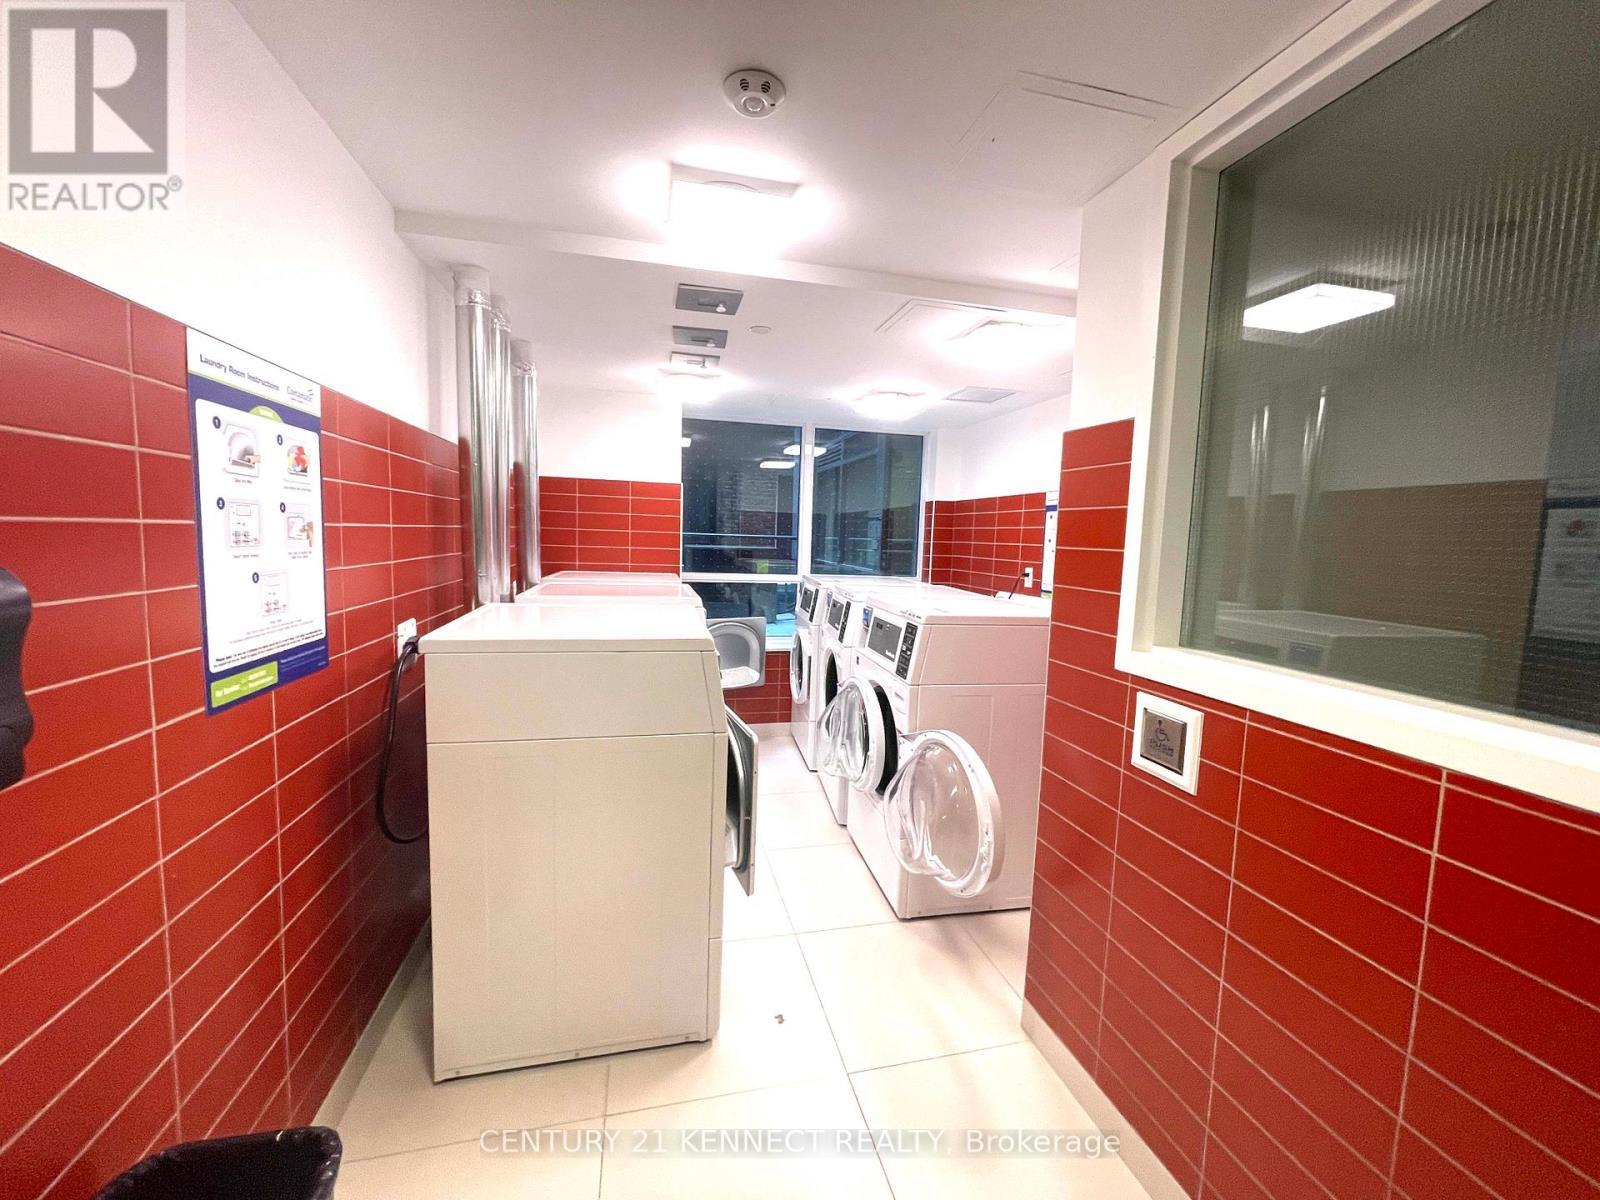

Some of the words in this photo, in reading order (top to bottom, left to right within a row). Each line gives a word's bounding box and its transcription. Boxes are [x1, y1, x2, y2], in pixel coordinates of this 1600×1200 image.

[199, 353, 227, 373] Laundry
[228, 364, 246, 379] Room
[246, 371, 280, 391] Instructions
